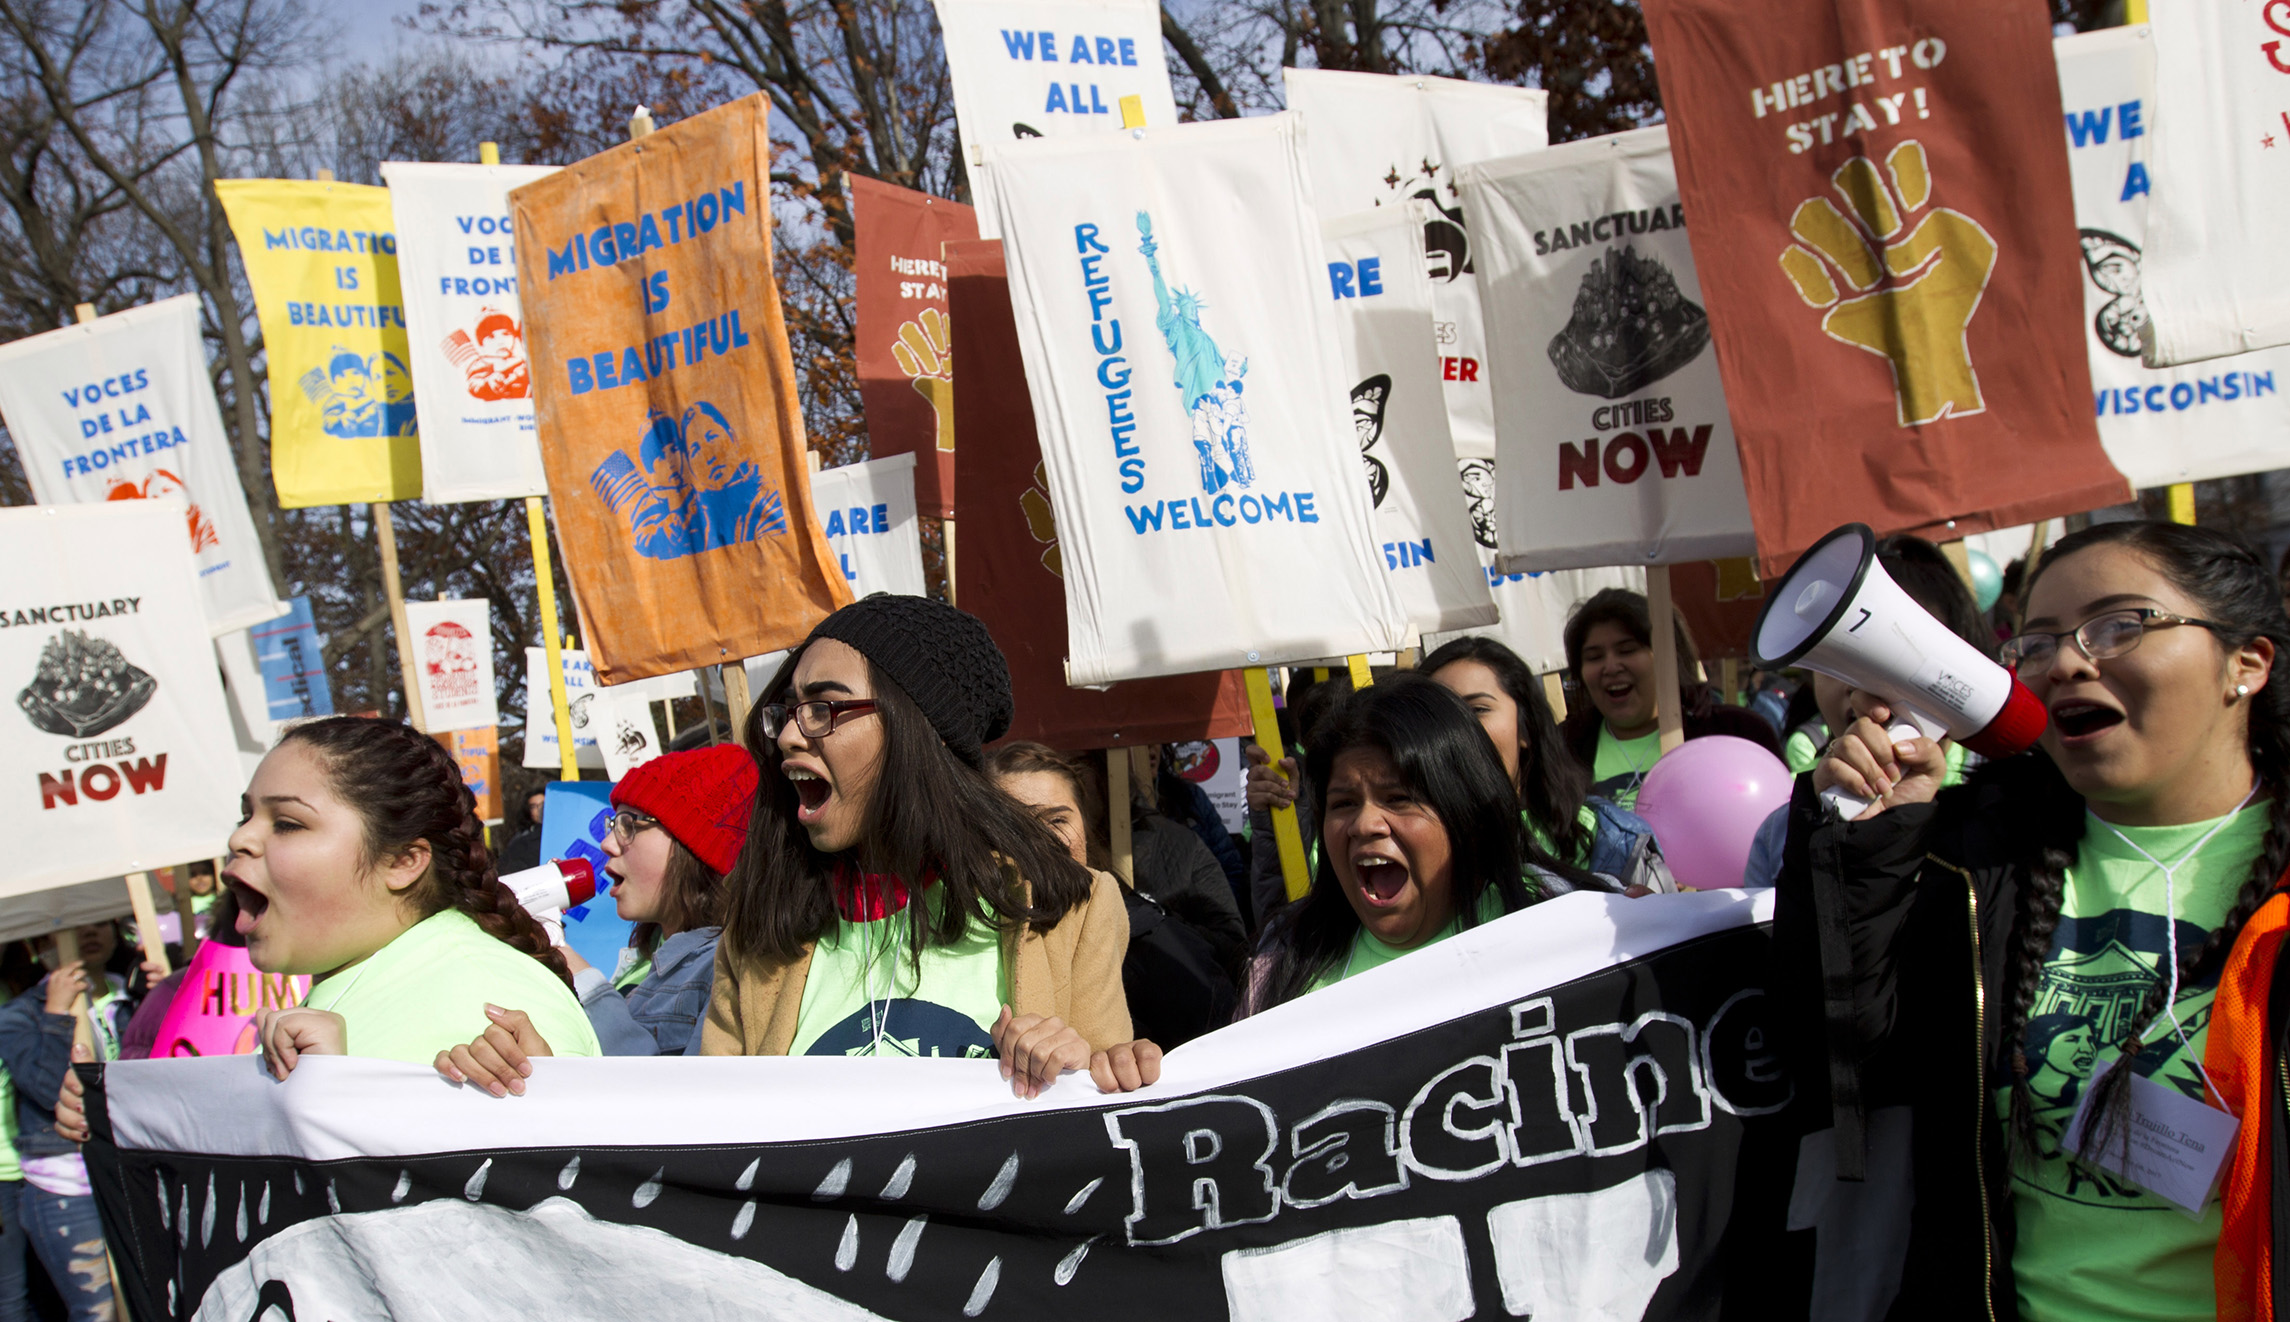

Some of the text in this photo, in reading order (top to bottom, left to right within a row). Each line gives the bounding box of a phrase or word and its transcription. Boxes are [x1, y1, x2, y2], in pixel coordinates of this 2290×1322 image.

[1000, 29, 1138, 66] WE ARE
[1045, 82, 1108, 114] ALL
[1751, 37, 1947, 119] HERE TO
[1786, 87, 1930, 154] STAY!
[2065, 98, 2144, 148] WE
[263, 227, 397, 255] MIGRATIO
[456, 216, 513, 234] VOC
[546, 180, 745, 281] MIGRATION
[1534, 203, 1687, 256] SANCTUAR
[468, 246, 501, 264] DE
[891, 255, 940, 277] HERE
[335, 267, 359, 290] IS
[440, 277, 518, 295] FRONT
[641, 269, 670, 316] IS
[1328, 256, 1383, 300] RE
[287, 302, 406, 329] BEAUTIFU
[567, 309, 749, 395] BEAUTIFUL
[1074, 223, 1145, 494] REFUGEES
[63, 368, 149, 408] VOCES
[80, 403, 151, 439] DE LA
[1592, 397, 1675, 431] CITIES
[63, 425, 188, 479] FRONTERA
[1559, 424, 1714, 490] NOW
[826, 503, 889, 539] ARE
[1124, 491, 1320, 535] WELCOME
[0, 597, 141, 627] SANCTUARY
[1849, 608, 1871, 632] 7
[282, 637, 316, 716] dical
[64, 736, 136, 763] CITIES
[38, 753, 167, 809] NOW
[202, 969, 311, 1016] HUM
[1103, 987, 1795, 1246] Racine
[2175, 1131, 2206, 1152] Tena
